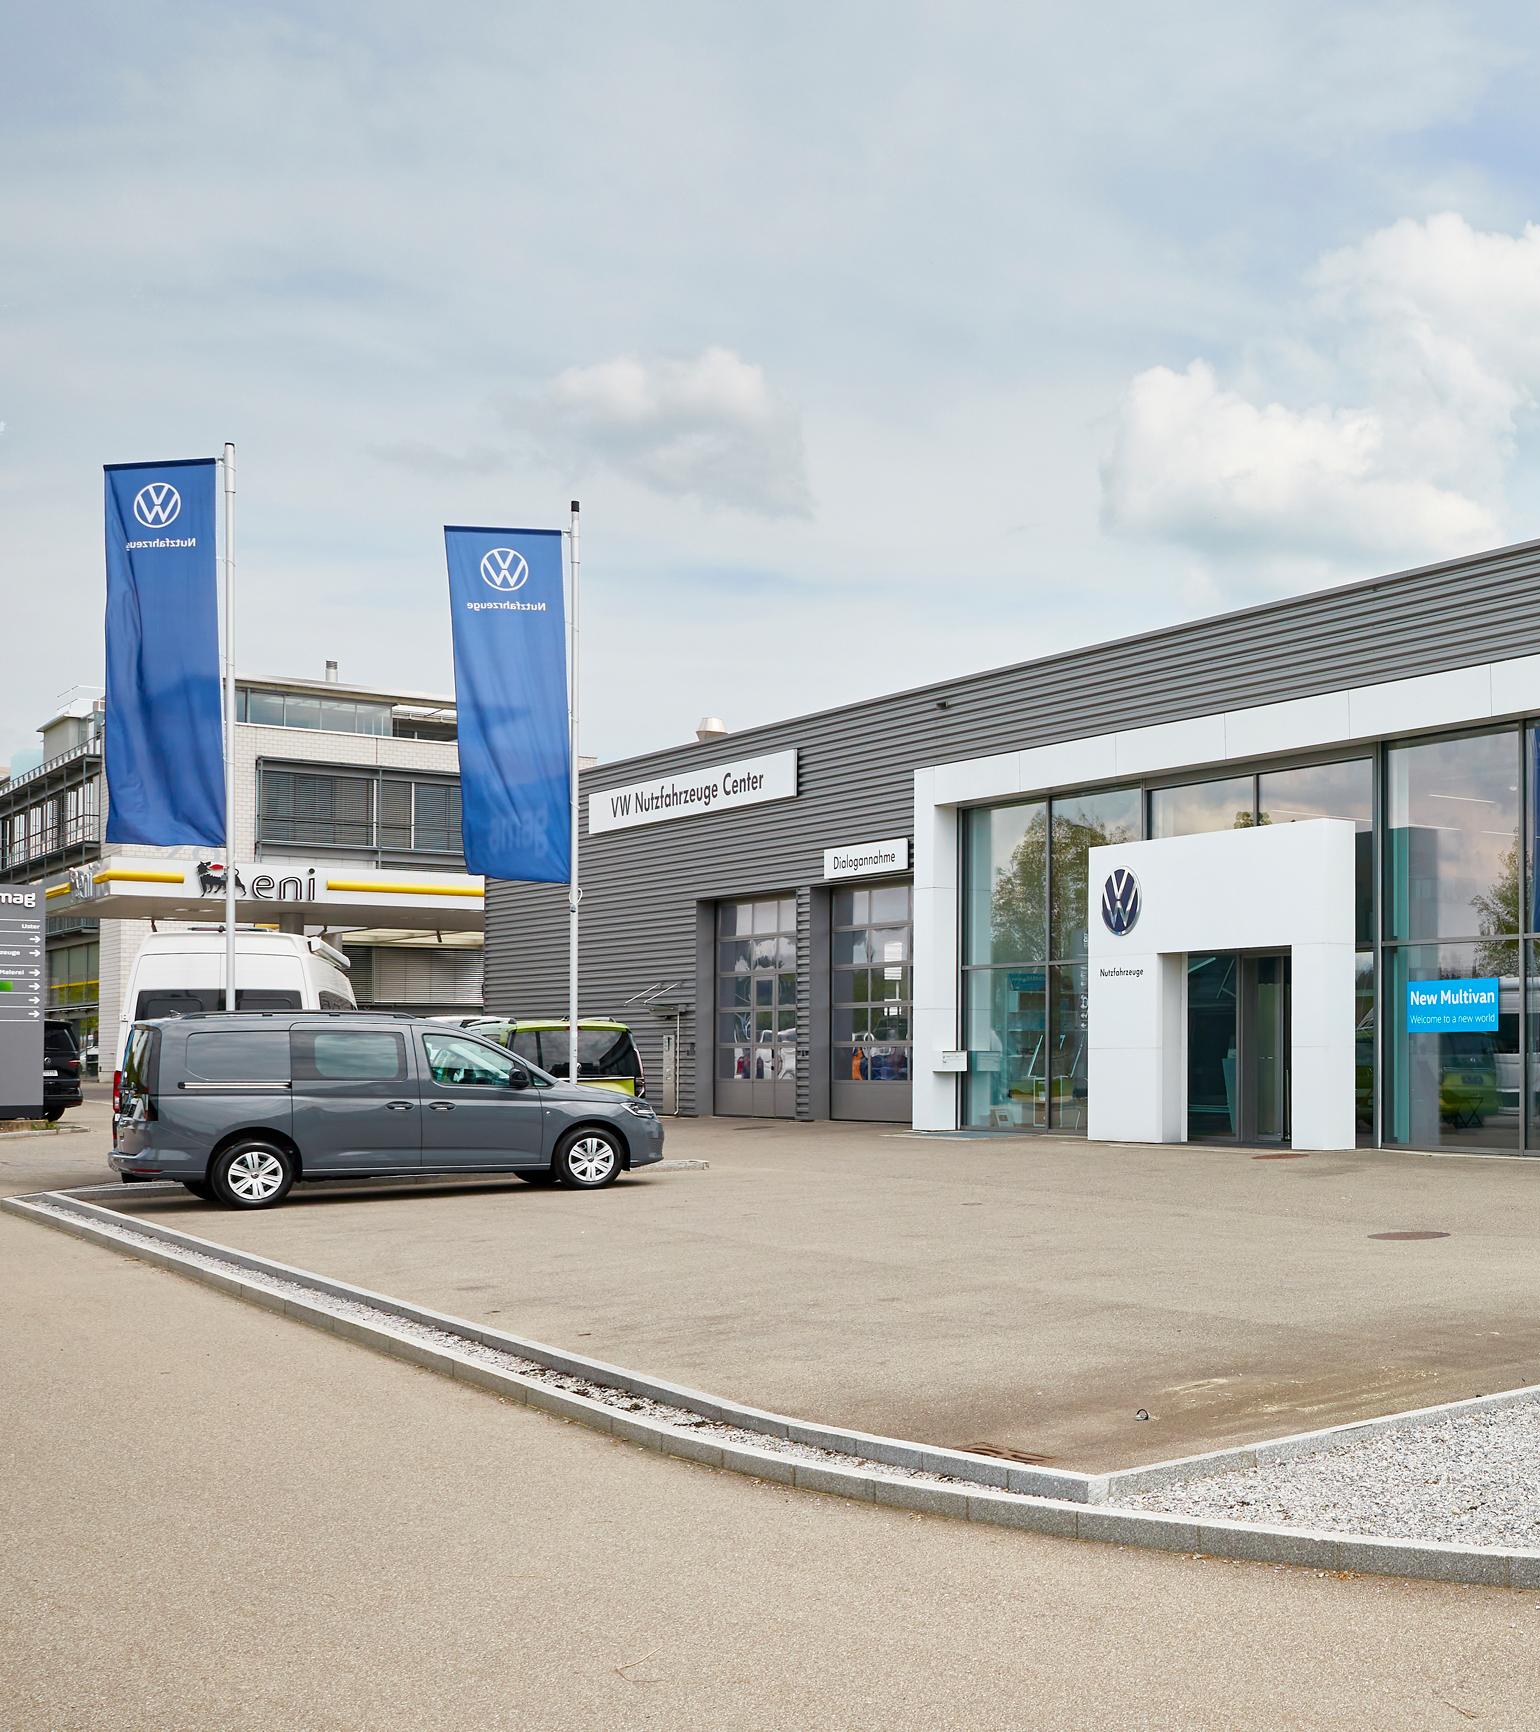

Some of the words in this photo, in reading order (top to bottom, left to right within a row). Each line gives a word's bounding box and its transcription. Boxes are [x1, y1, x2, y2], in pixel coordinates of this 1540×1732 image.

[610, 794, 632, 818] VW
[634, 783, 718, 814] Nutzfahrzeuge
[722, 772, 764, 796] Center
[832, 849, 896, 871] Dialogannahme
[252, 867, 316, 900] eni
[1099, 967, 1144, 978] Nutzfahrzeuge
[1410, 990, 1438, 1006] New
[1440, 987, 1495, 1005] Multivan
[1410, 1014, 1442, 1024] Welcome
[1443, 1014, 1450, 1023] to
[1458, 1015, 1473, 1023] new
[1474, 1012, 1495, 1023] world
